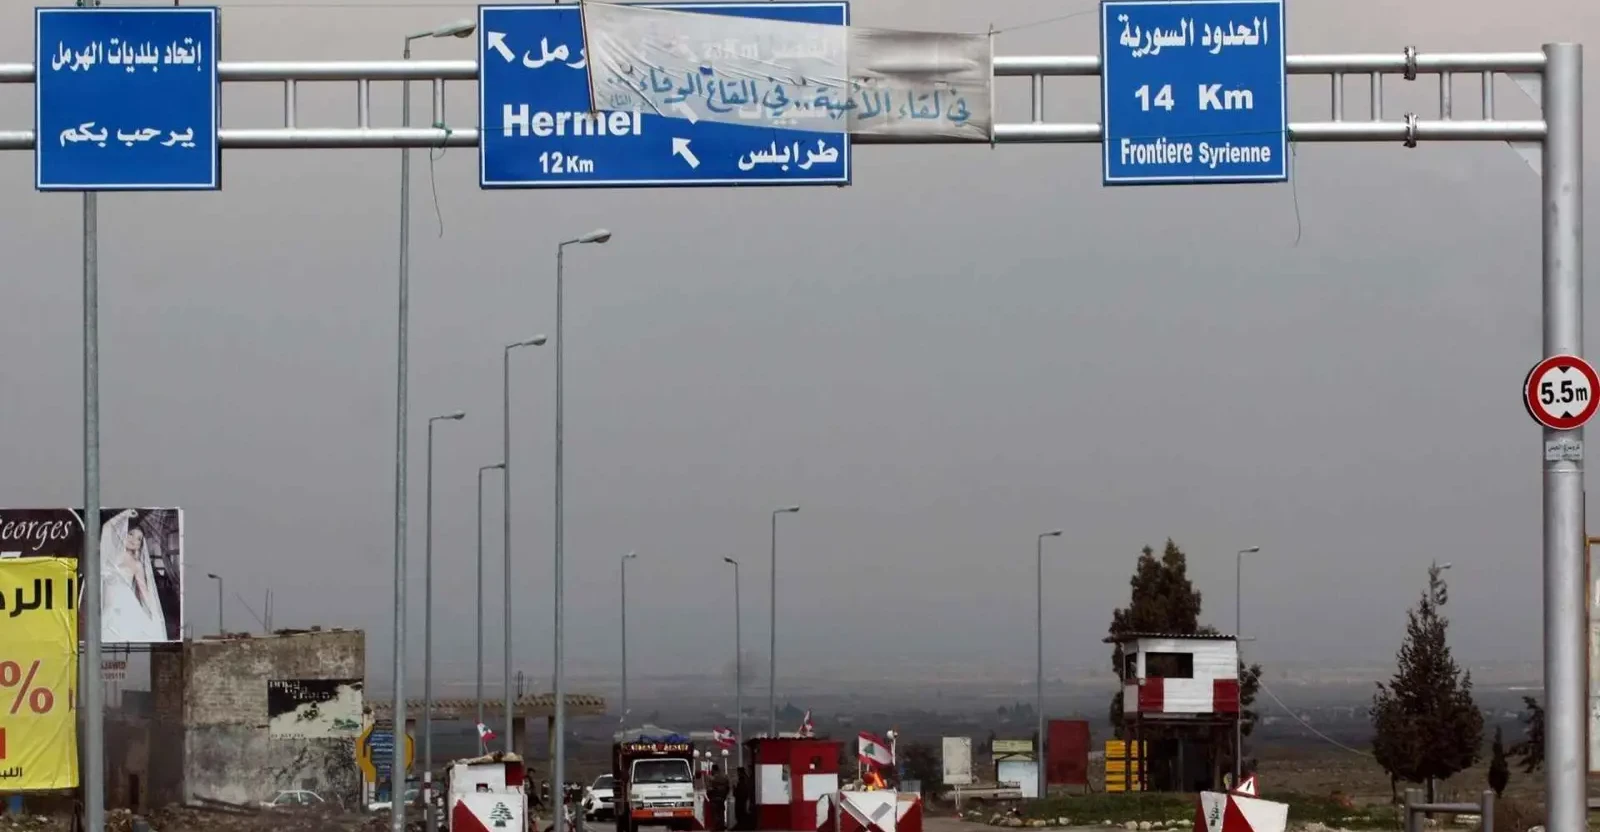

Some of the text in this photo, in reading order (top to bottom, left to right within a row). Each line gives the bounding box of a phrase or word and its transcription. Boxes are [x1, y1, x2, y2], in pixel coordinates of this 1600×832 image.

[1118, 14, 1268, 58] الحدود السورية
[51, 41, 103, 71] الهرمل
[107, 38, 159, 73] بلديات
[522, 36, 586, 69] رمل
[706, 79, 758, 113] القاع
[899, 89, 941, 121] لقاء
[946, 88, 972, 126] في
[1134, 83, 1254, 112] 14 Km
[60, 122, 196, 147] يرحب بكم
[503, 103, 642, 137] Hermel
[539, 151, 594, 173] 12 Km
[738, 139, 839, 171] طرابلس
[1120, 137, 1271, 169] Frontiere Syrienne
[1541, 380, 1588, 405] 5.5m
[0, 519, 72, 551] eorges
